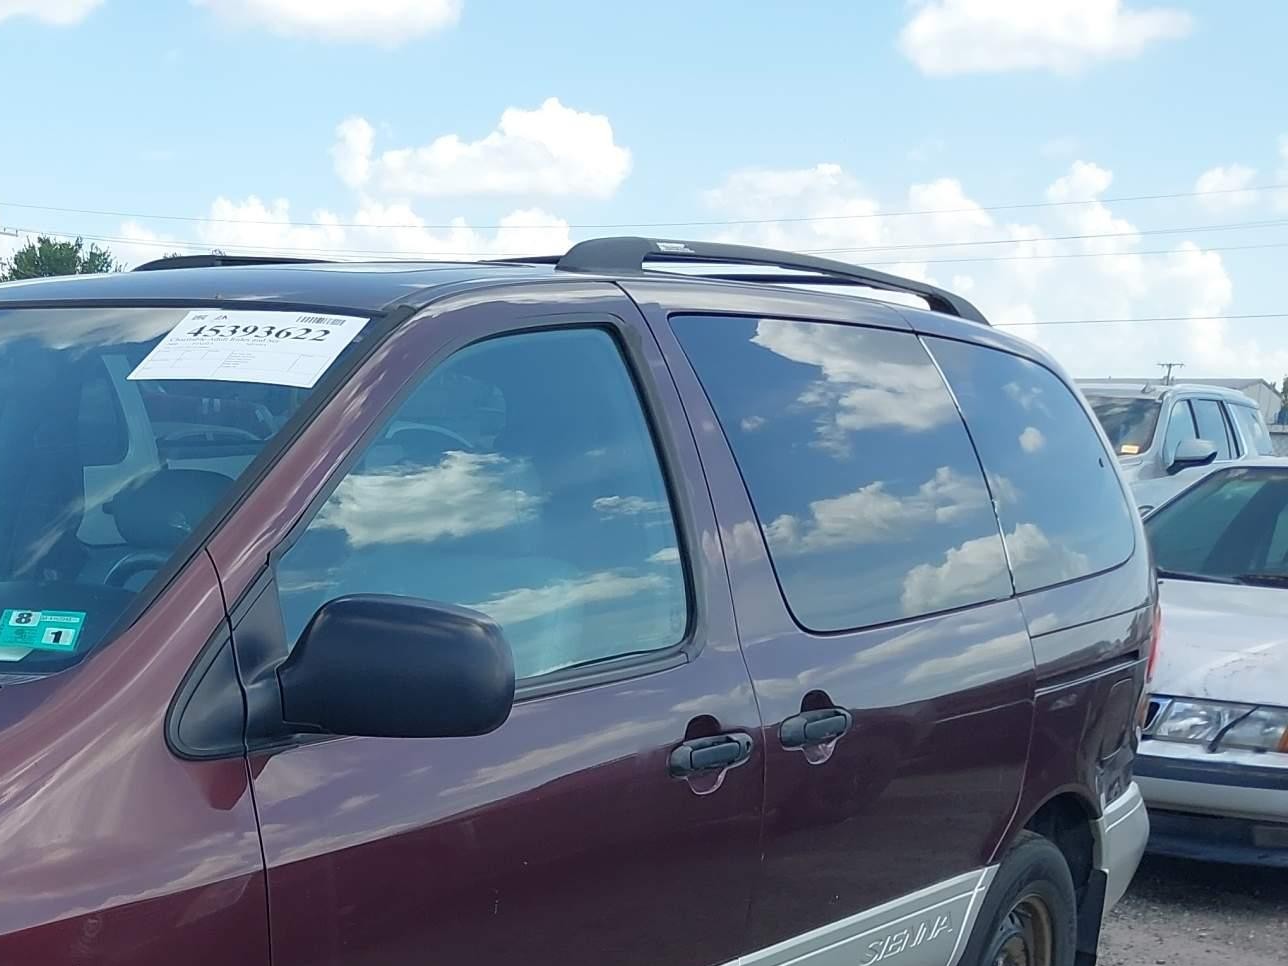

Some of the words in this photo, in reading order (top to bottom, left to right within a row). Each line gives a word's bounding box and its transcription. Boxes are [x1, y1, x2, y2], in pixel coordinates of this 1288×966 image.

[187, 324, 331, 342] 45393622
[15, 612, 33, 625] 8
[50, 630, 63, 644] 1
[858, 911, 955, 966] SIENNA
